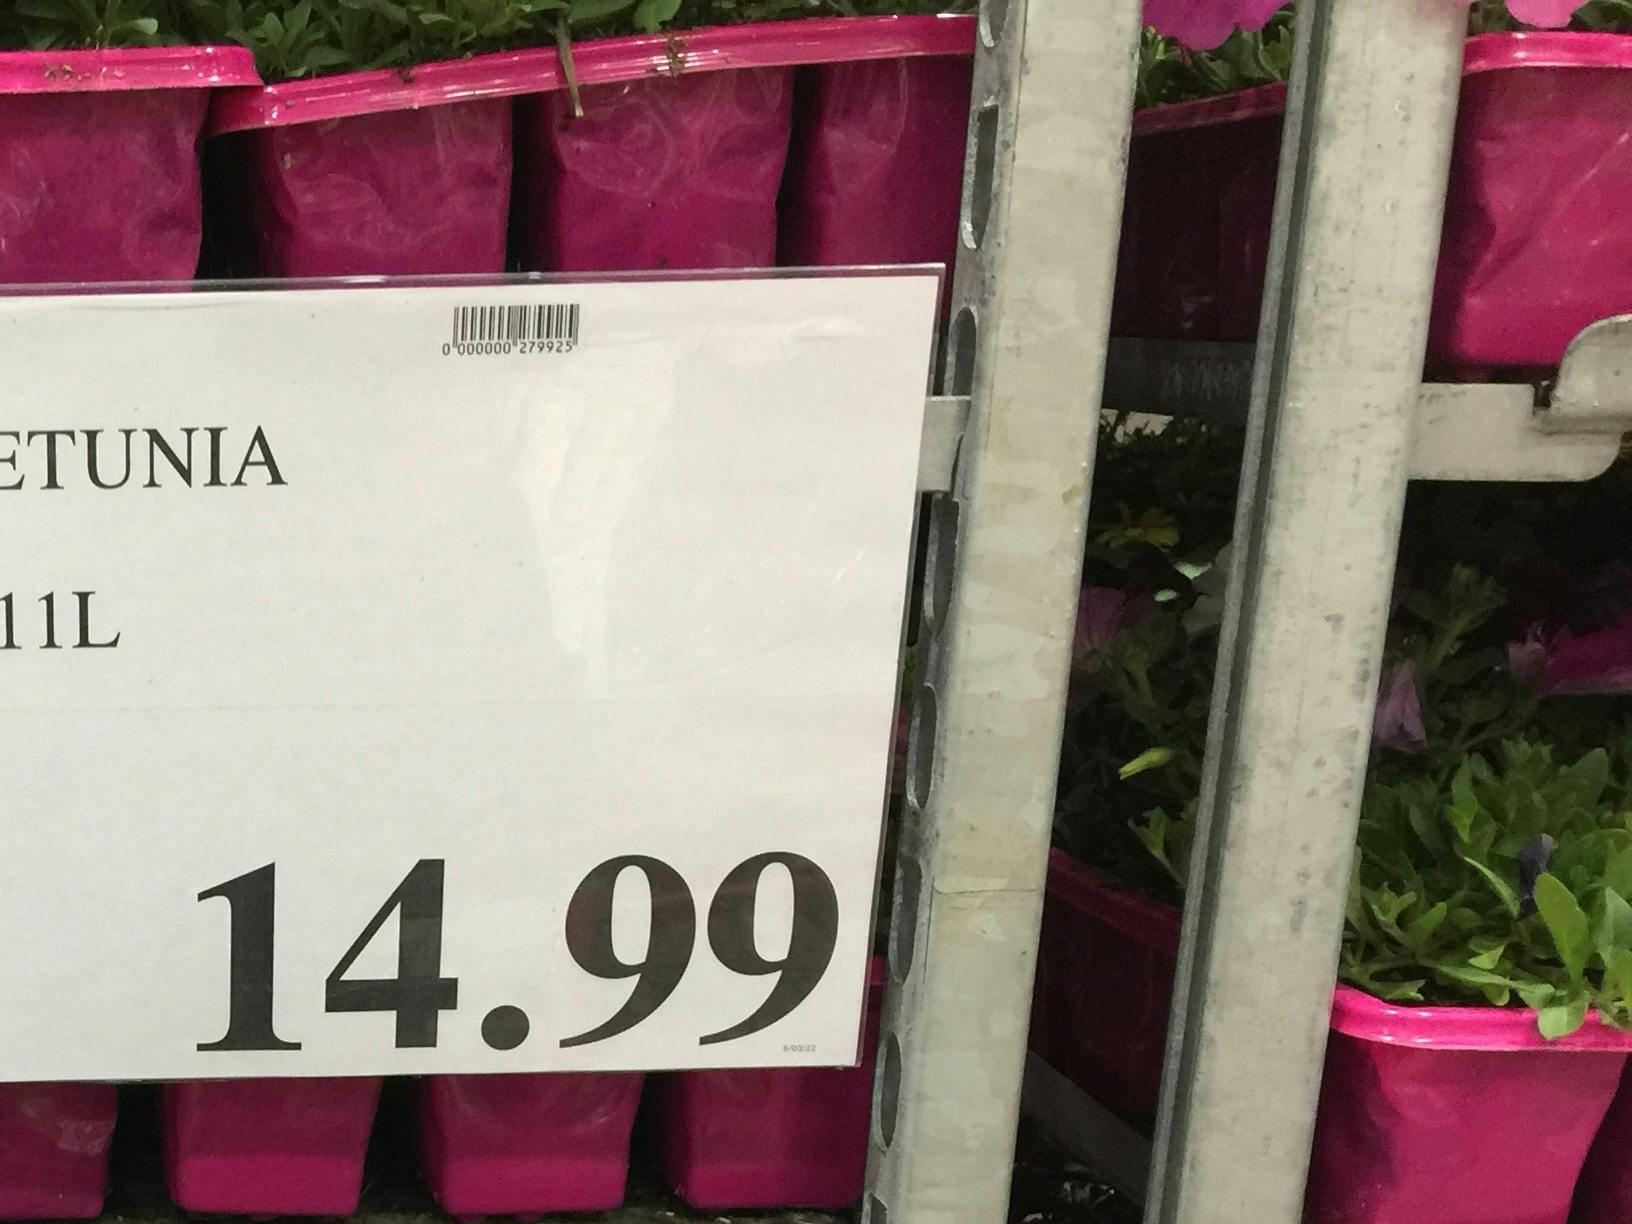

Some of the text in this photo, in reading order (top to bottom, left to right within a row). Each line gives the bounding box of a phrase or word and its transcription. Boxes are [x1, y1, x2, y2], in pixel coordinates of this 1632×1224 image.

[442, 340, 574, 356] 0 000000 279925
[195, 850, 840, 1053] 14.99
